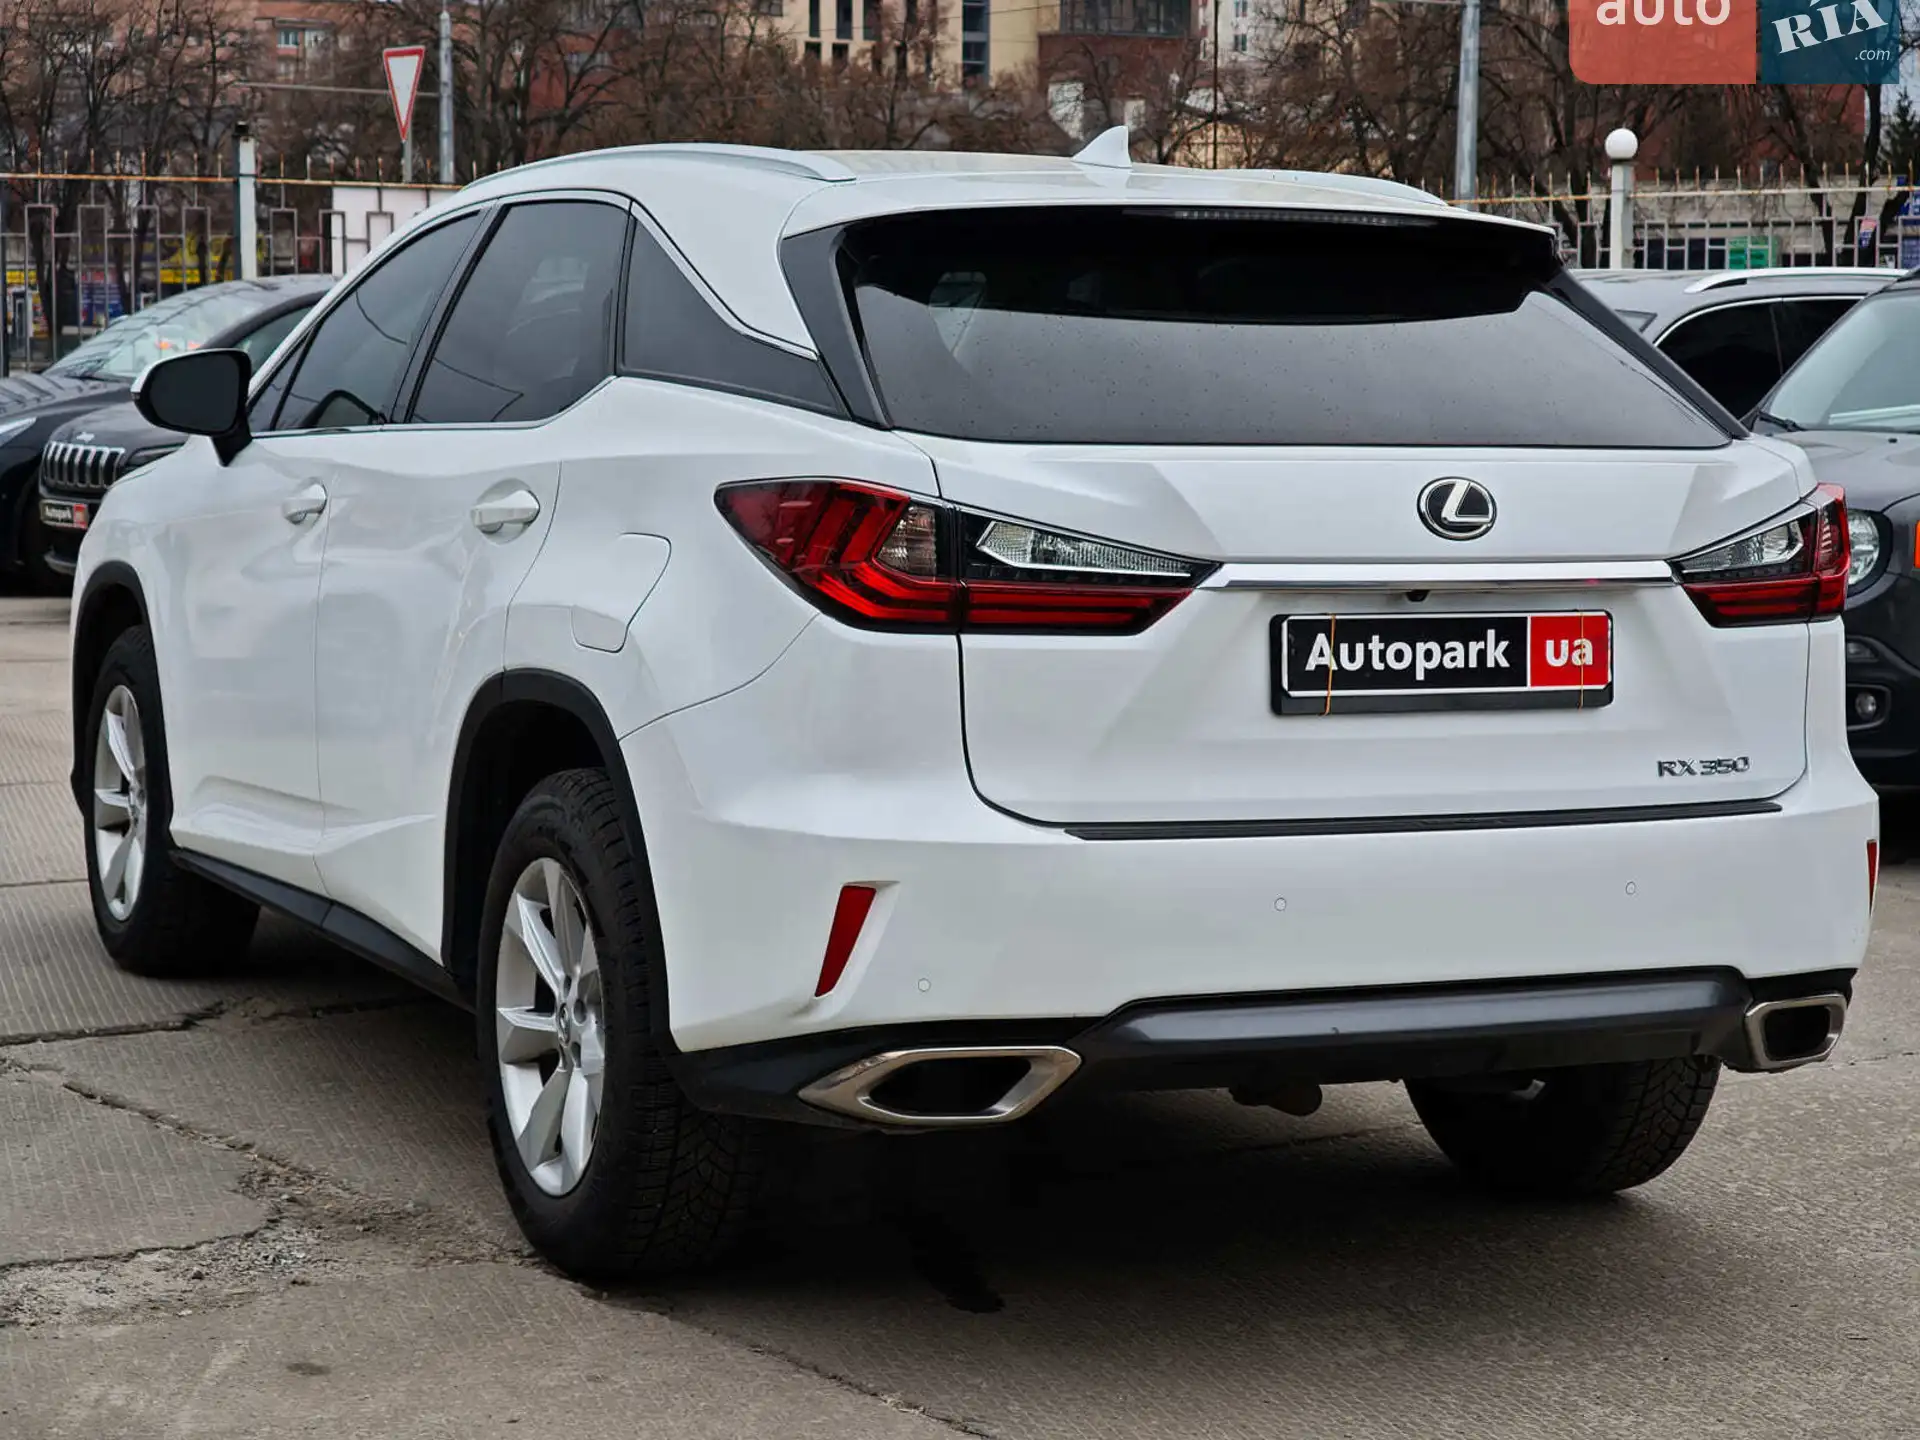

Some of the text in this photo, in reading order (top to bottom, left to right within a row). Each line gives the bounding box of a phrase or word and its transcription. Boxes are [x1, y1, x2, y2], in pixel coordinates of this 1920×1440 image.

[1304, 628, 1594, 681] Autopark ua
[1657, 756, 1750, 777] RX 350
